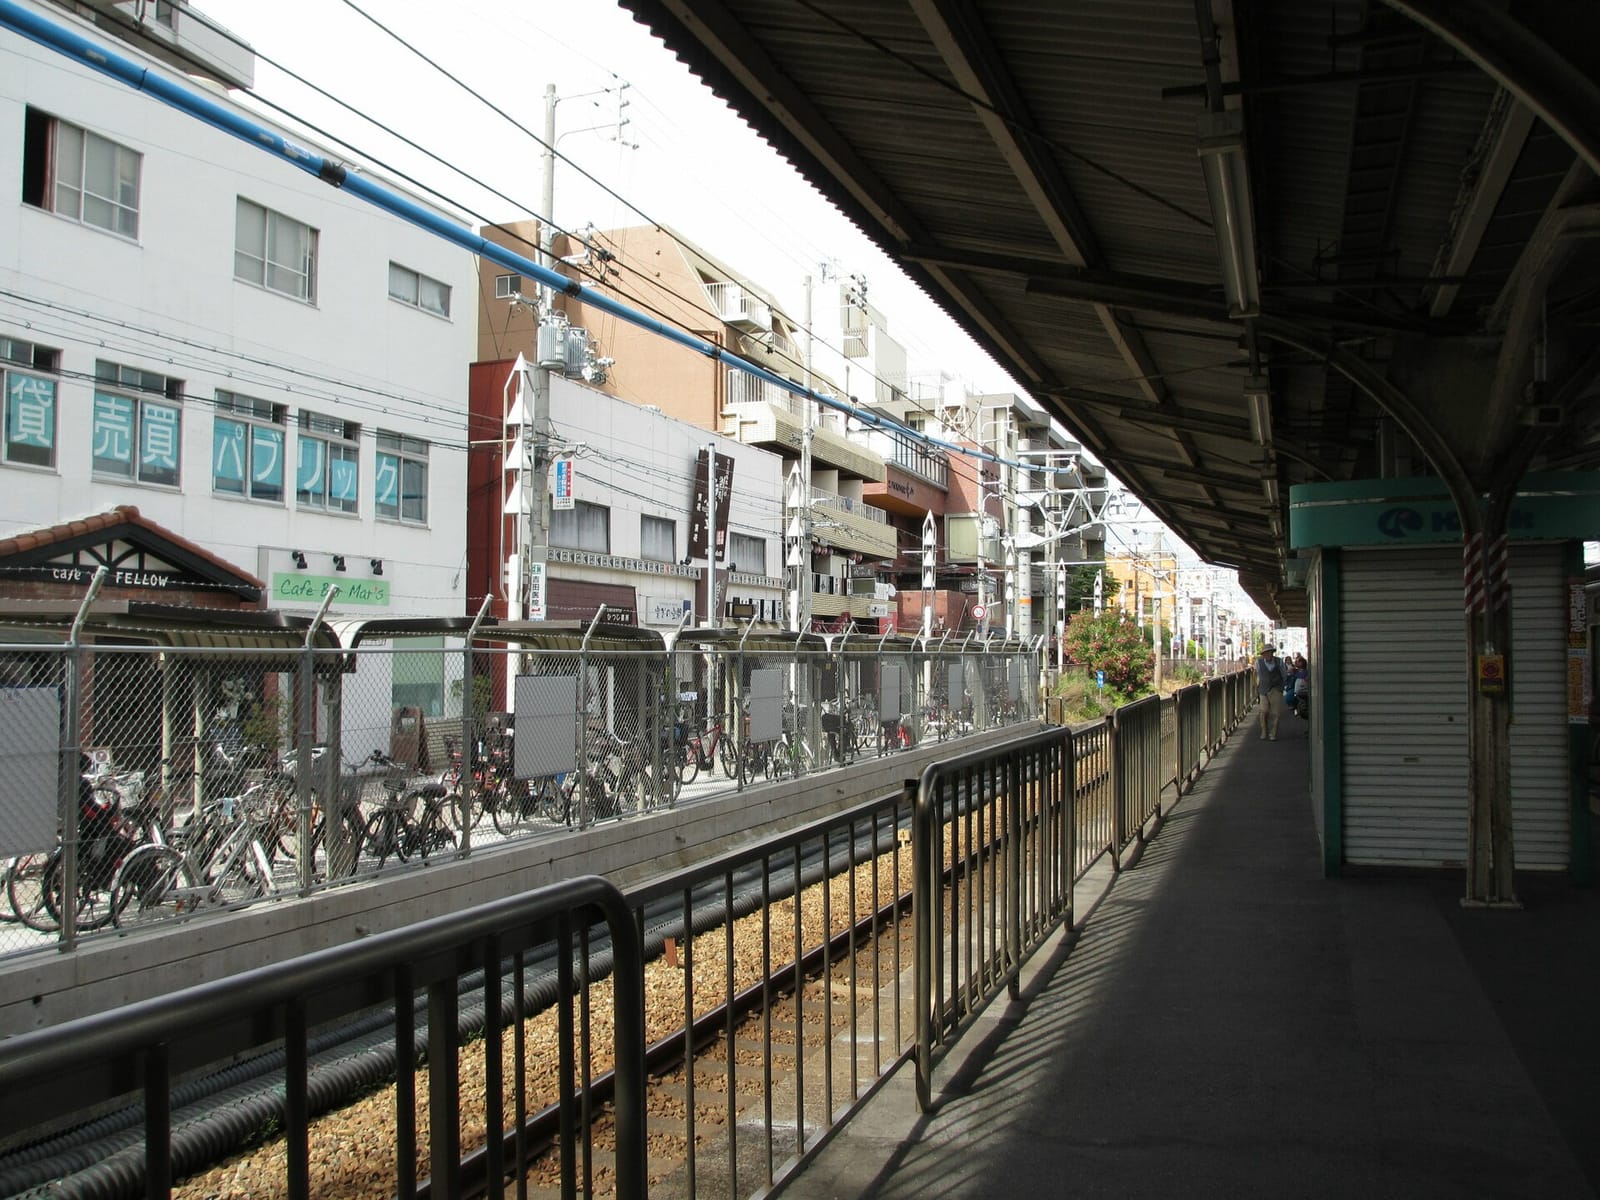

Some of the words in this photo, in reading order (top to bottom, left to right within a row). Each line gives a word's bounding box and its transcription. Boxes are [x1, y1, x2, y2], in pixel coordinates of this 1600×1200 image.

[11, 378, 53, 448] 貸
[93, 397, 177, 470] 売買
[216, 424, 398, 503] パブリック
[115, 571, 169, 587] FELLOW
[280, 578, 313, 597] Cafe
[349, 584, 384, 601] Mar's
